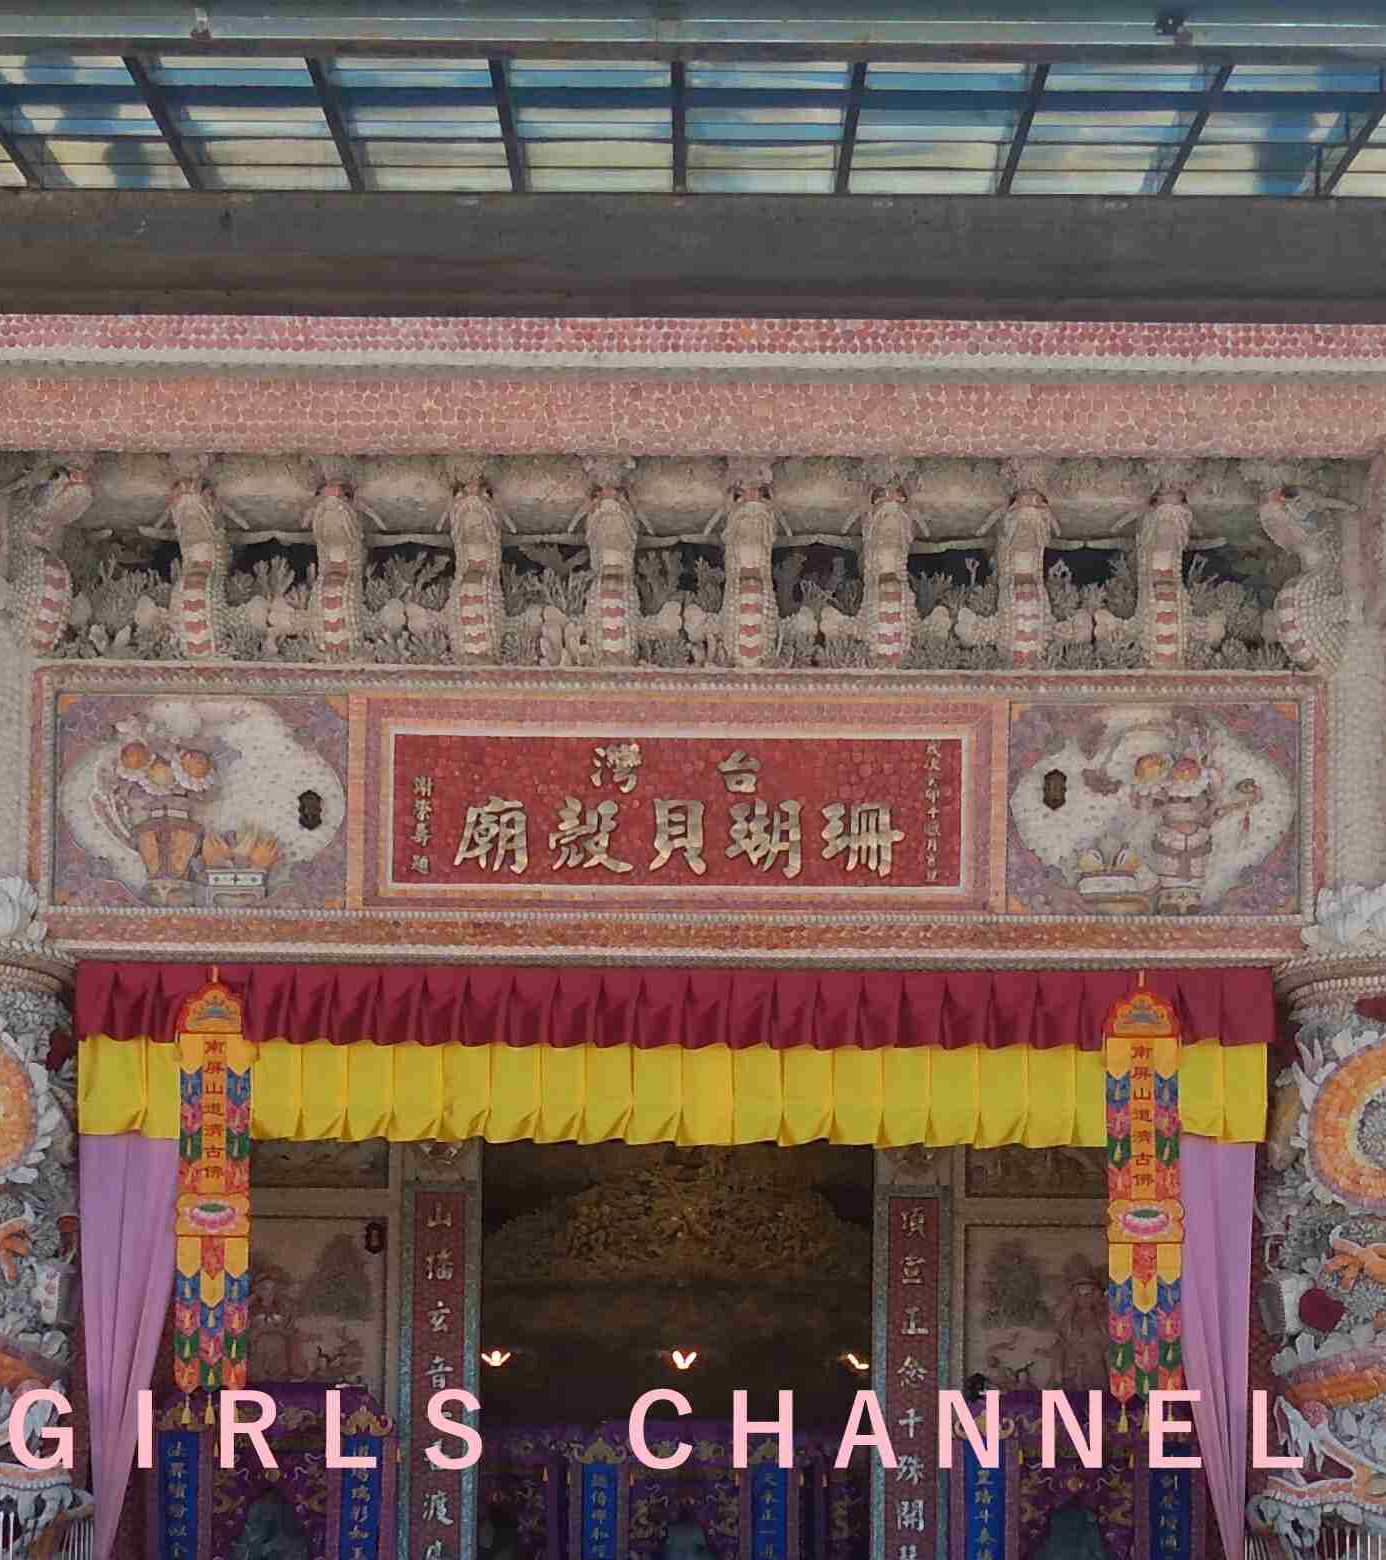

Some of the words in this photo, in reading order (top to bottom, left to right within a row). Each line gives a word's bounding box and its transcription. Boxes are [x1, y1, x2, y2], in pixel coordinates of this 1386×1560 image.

[590, 743, 762, 795] 台灣
[452, 795, 907, 879] 珊瑚貝殼廟
[1131, 1043, 1155, 1188] 南屏山道濟古佛
